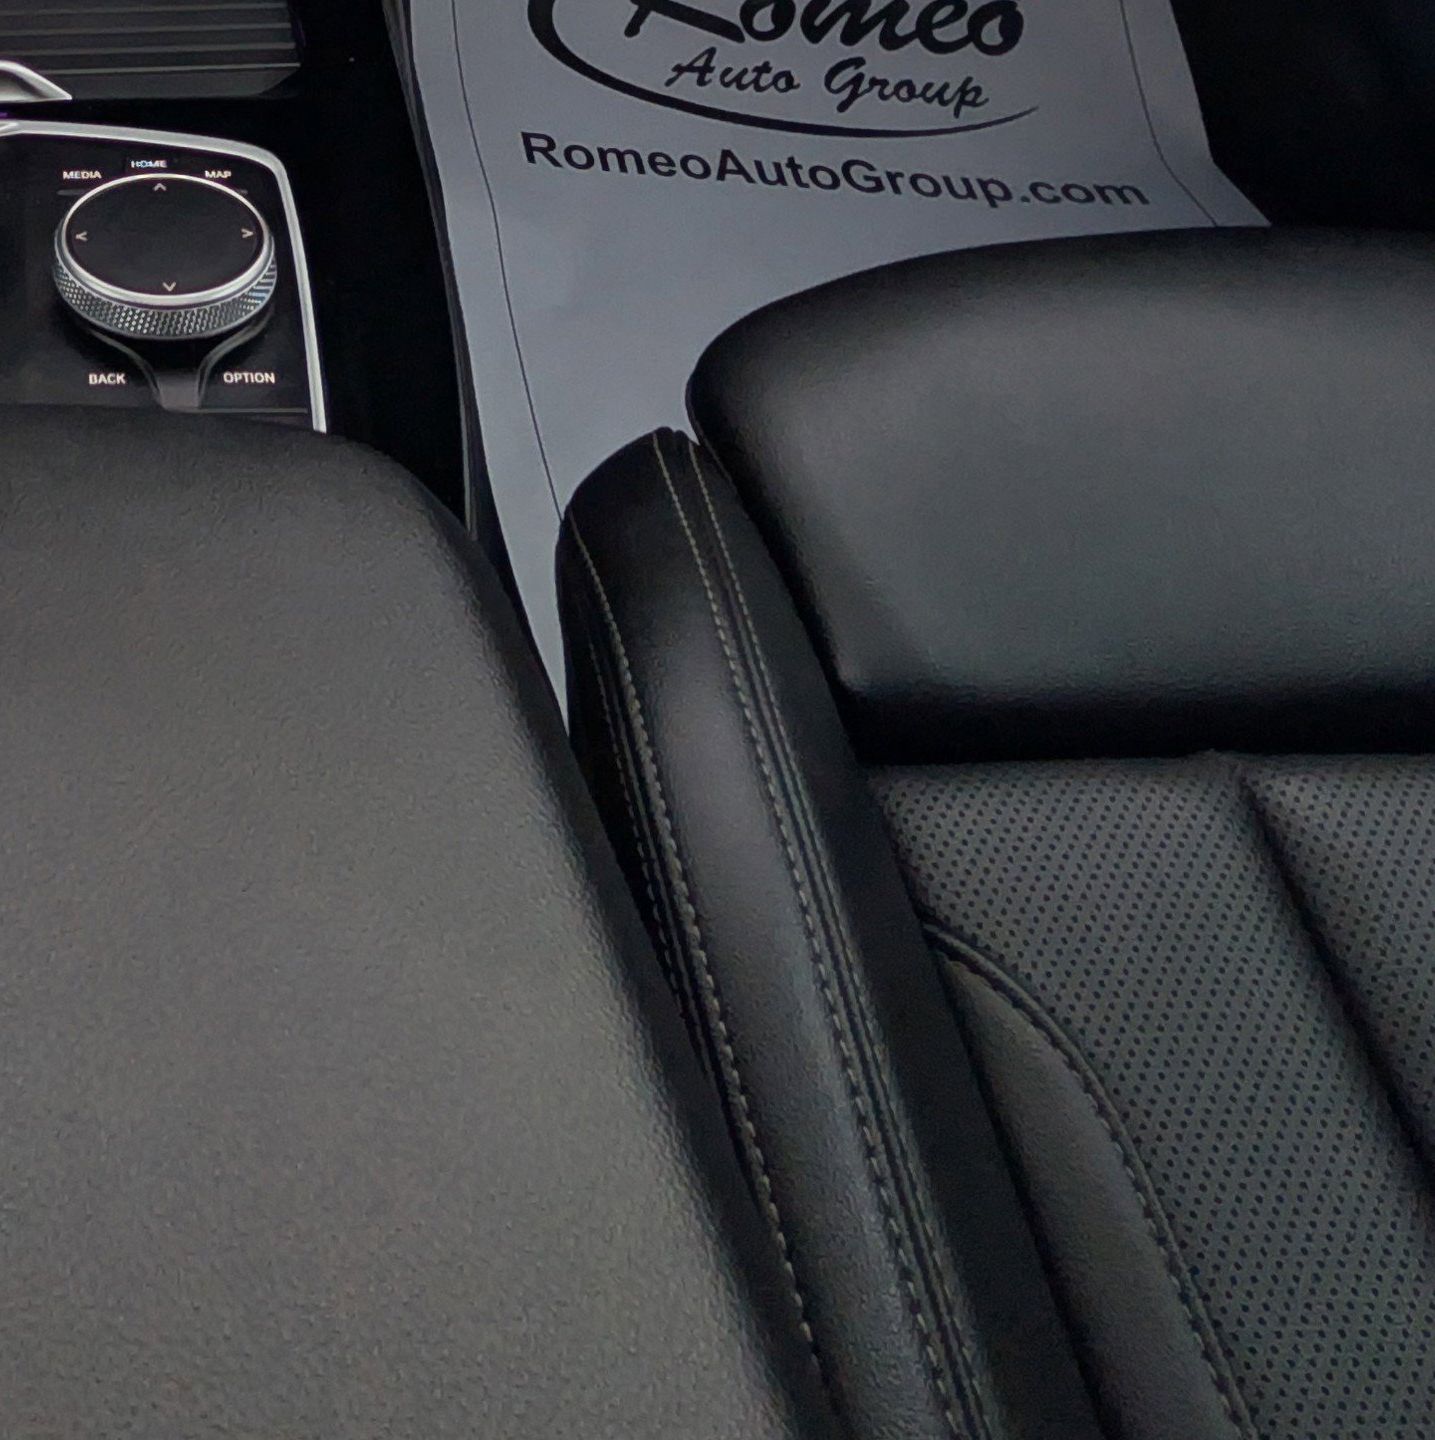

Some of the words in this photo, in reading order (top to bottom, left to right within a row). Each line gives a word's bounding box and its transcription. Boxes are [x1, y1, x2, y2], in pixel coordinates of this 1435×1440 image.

[665, 47, 801, 88] Auto
[823, 56, 990, 118] Group
[131, 159, 167, 169] HOME
[520, 130, 1150, 209] RomeoAutoGroup.com
[63, 170, 102, 180] MEDIA
[204, 170, 232, 179] MAP
[89, 373, 126, 385] BACK
[223, 372, 276, 384] OPTION
